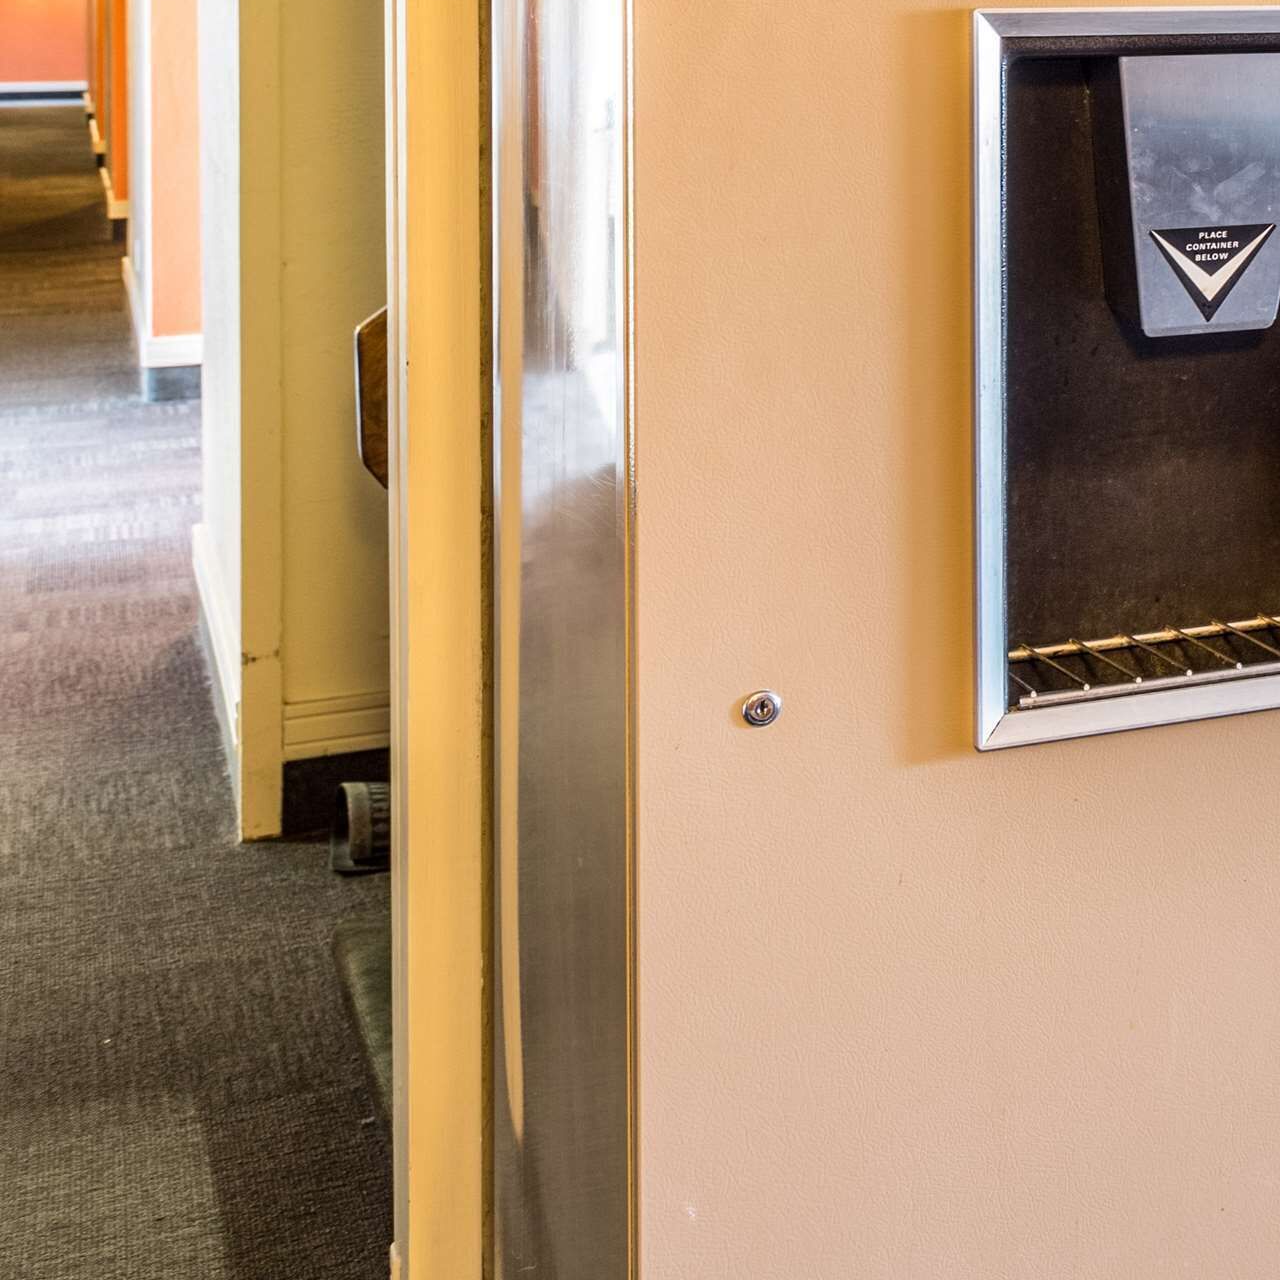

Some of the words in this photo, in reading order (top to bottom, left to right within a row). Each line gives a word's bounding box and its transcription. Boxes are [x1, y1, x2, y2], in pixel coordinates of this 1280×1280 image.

[1198, 230, 1228, 239] PLACE
[1186, 241, 1239, 251] CONTAINER
[1195, 252, 1229, 262] BELOW
